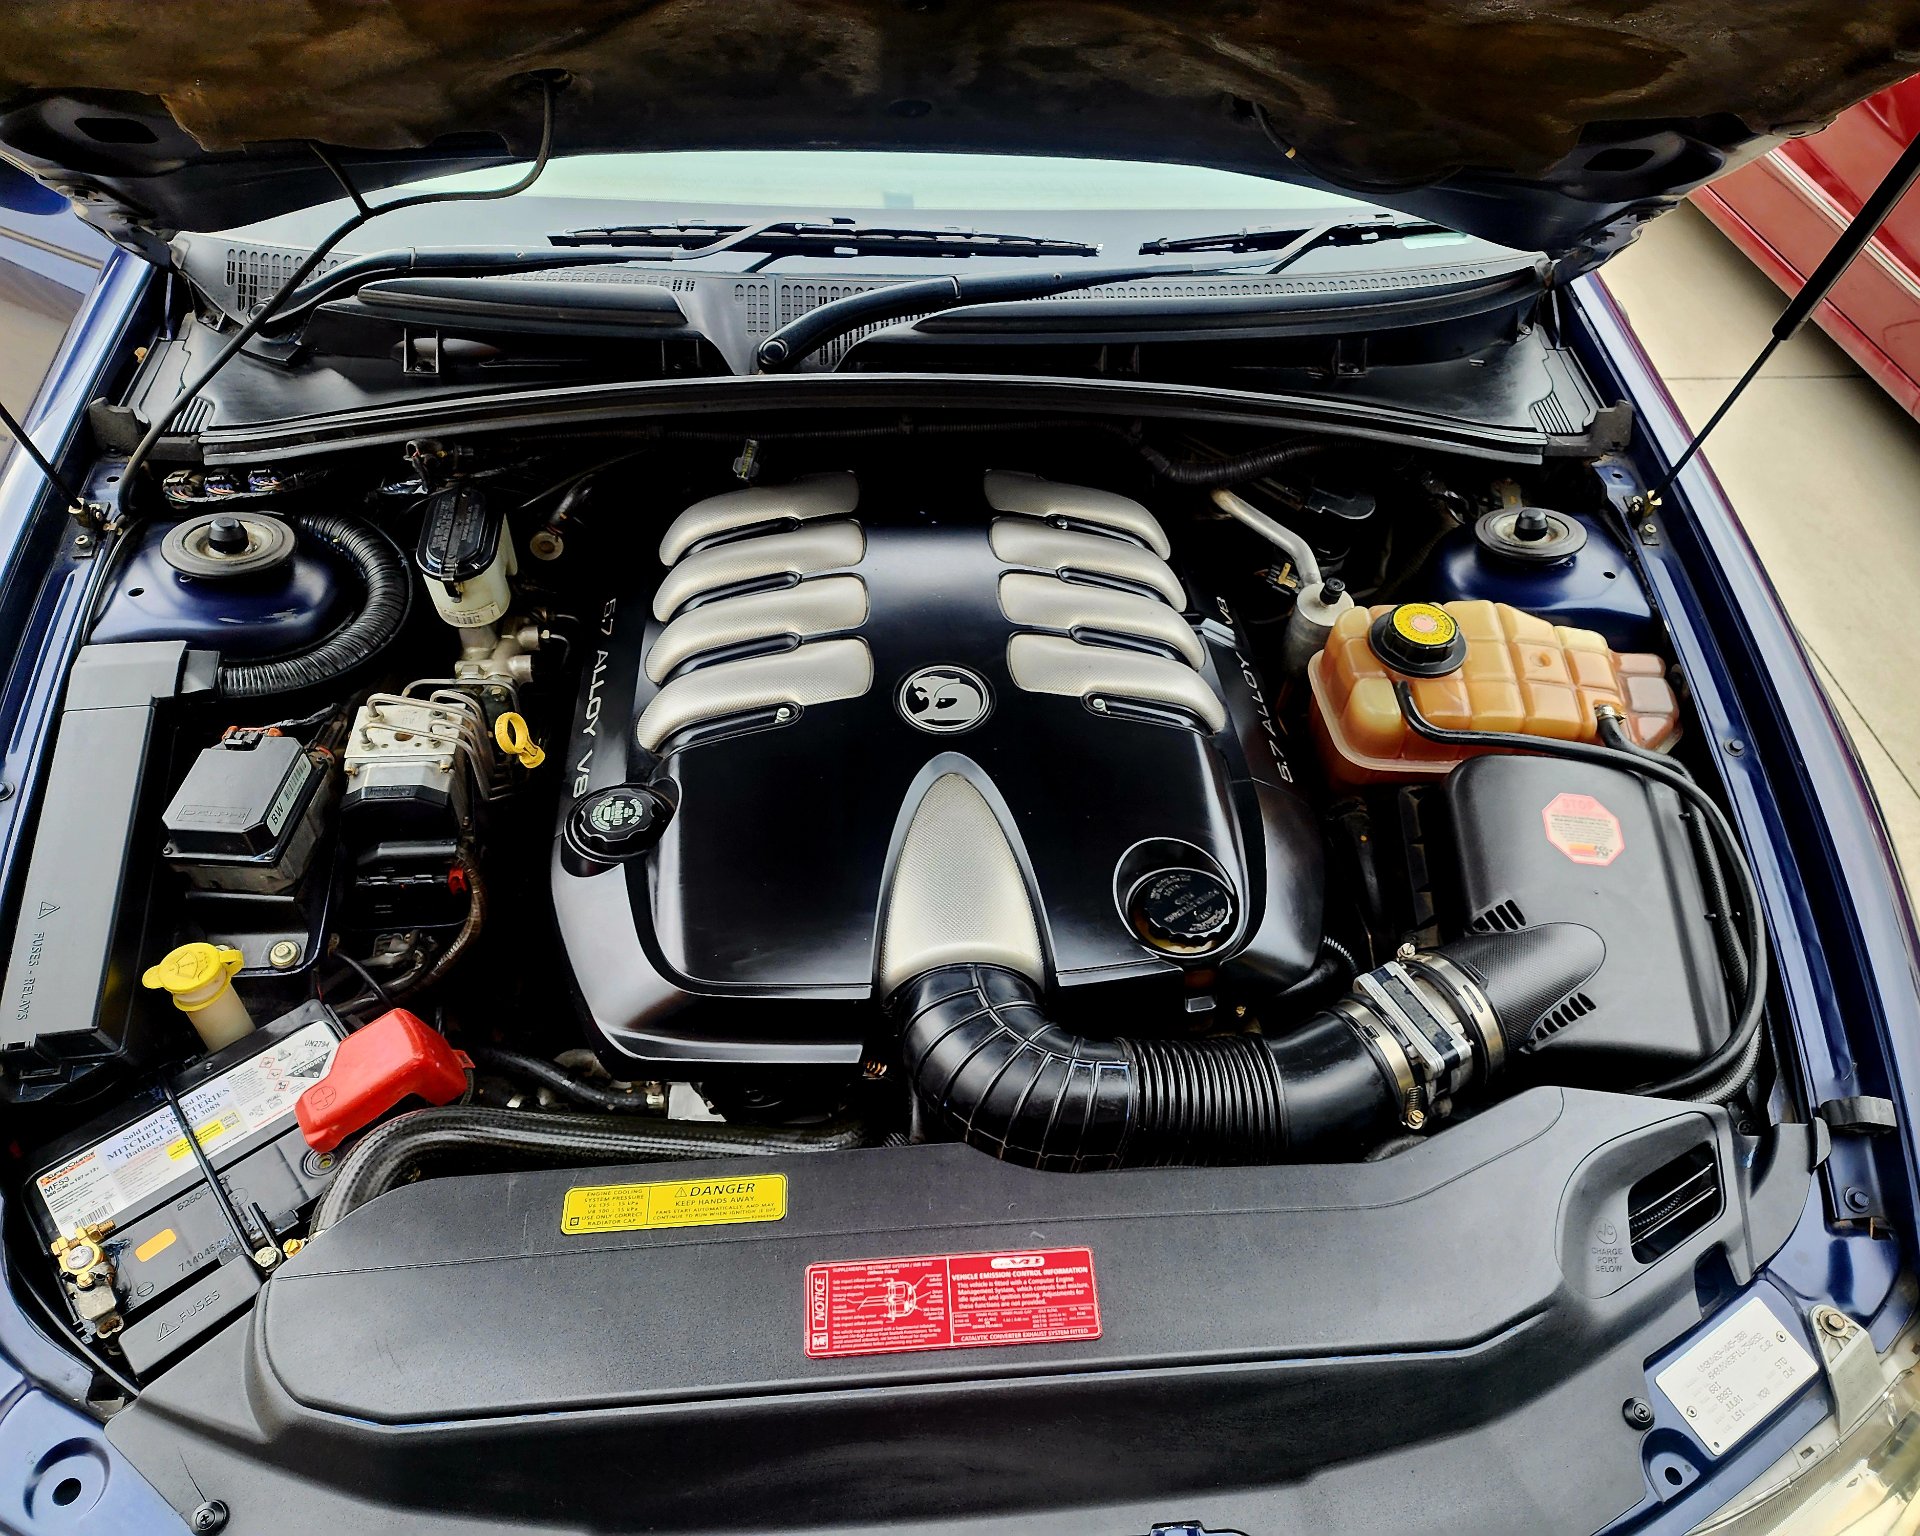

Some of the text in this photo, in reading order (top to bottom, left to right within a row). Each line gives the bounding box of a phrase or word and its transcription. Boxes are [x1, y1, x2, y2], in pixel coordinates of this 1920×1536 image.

[573, 599, 616, 798] 5.7 ALLOY V8
[1216, 596, 1293, 783] 5.7 ALLOY V8
[29, 932, 44, 967] FUSES
[17, 974, 36, 1020] RELAYS
[106, 1121, 168, 1161] MITCHELL
[169, 1086, 230, 1125] BTTERIES
[122, 1128, 141, 1142] Sold
[142, 1118, 158, 1131] and
[125, 1134, 163, 1159] Bathurst
[690, 1182, 755, 1196] DANGER
[1012, 1269, 1041, 1277] CONTROL
[1043, 1267, 1087, 1275] INFORMATION
[177, 1290, 220, 1325] FUSES
[815, 1277, 825, 1321] NOTICE
